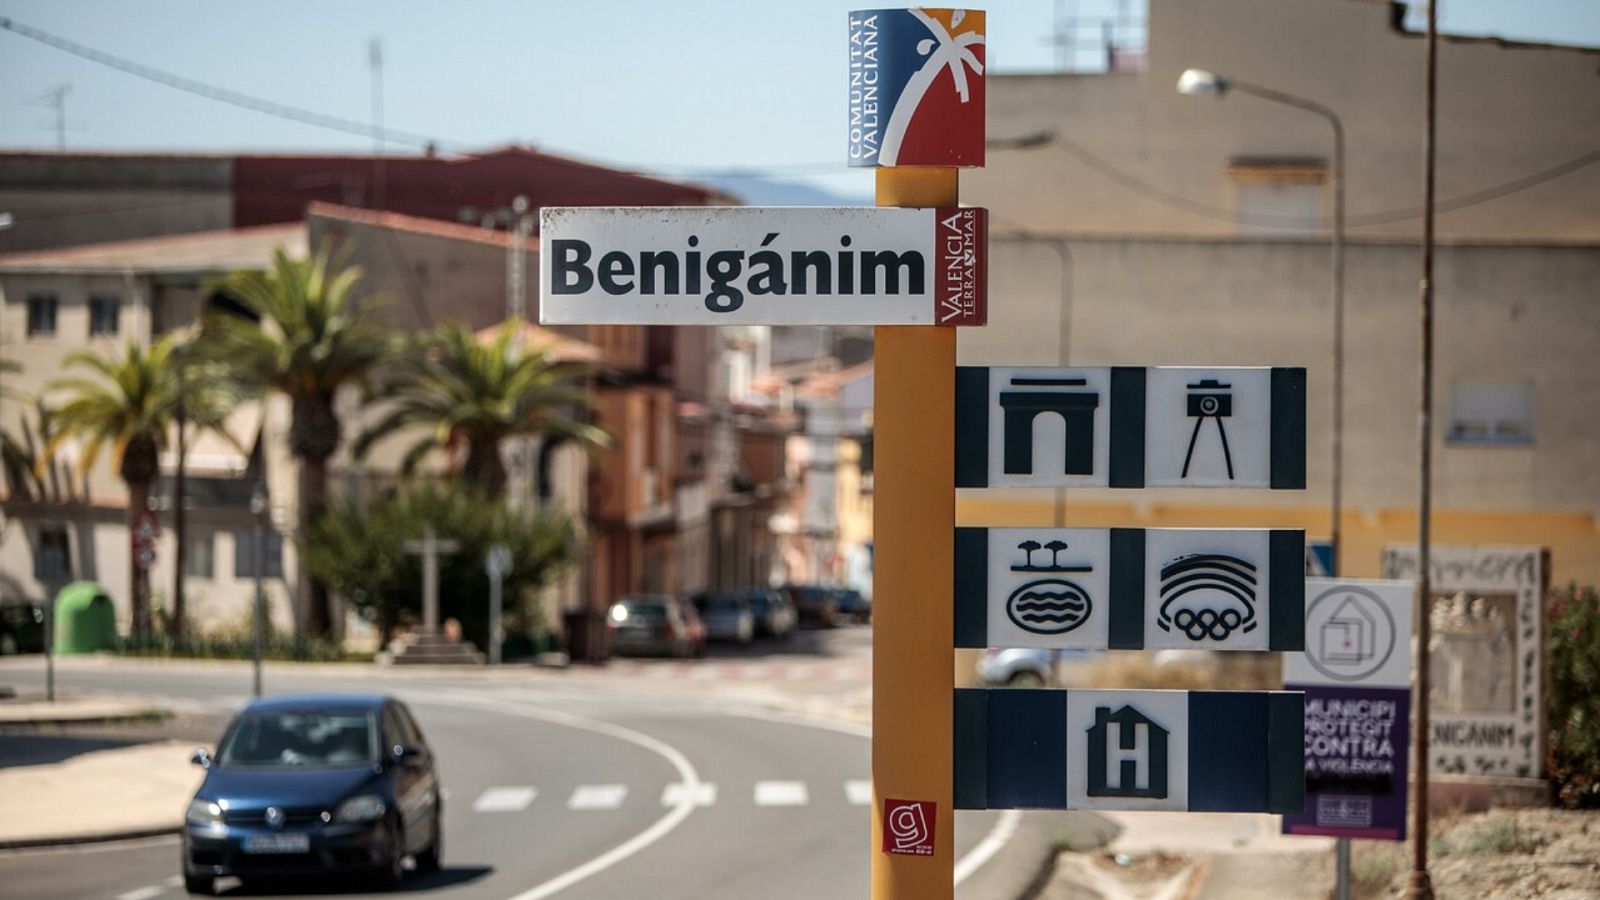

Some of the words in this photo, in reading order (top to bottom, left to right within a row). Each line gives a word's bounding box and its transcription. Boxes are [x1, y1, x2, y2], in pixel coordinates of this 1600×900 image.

[850, 16, 862, 159] COMUNITAT
[863, 14, 878, 159] VALENCIANA
[551, 232, 925, 313] Benigánim
[941, 211, 963, 322] VALENCIA
[964, 210, 974, 247] MAR
[964, 268, 974, 318] TERRA
